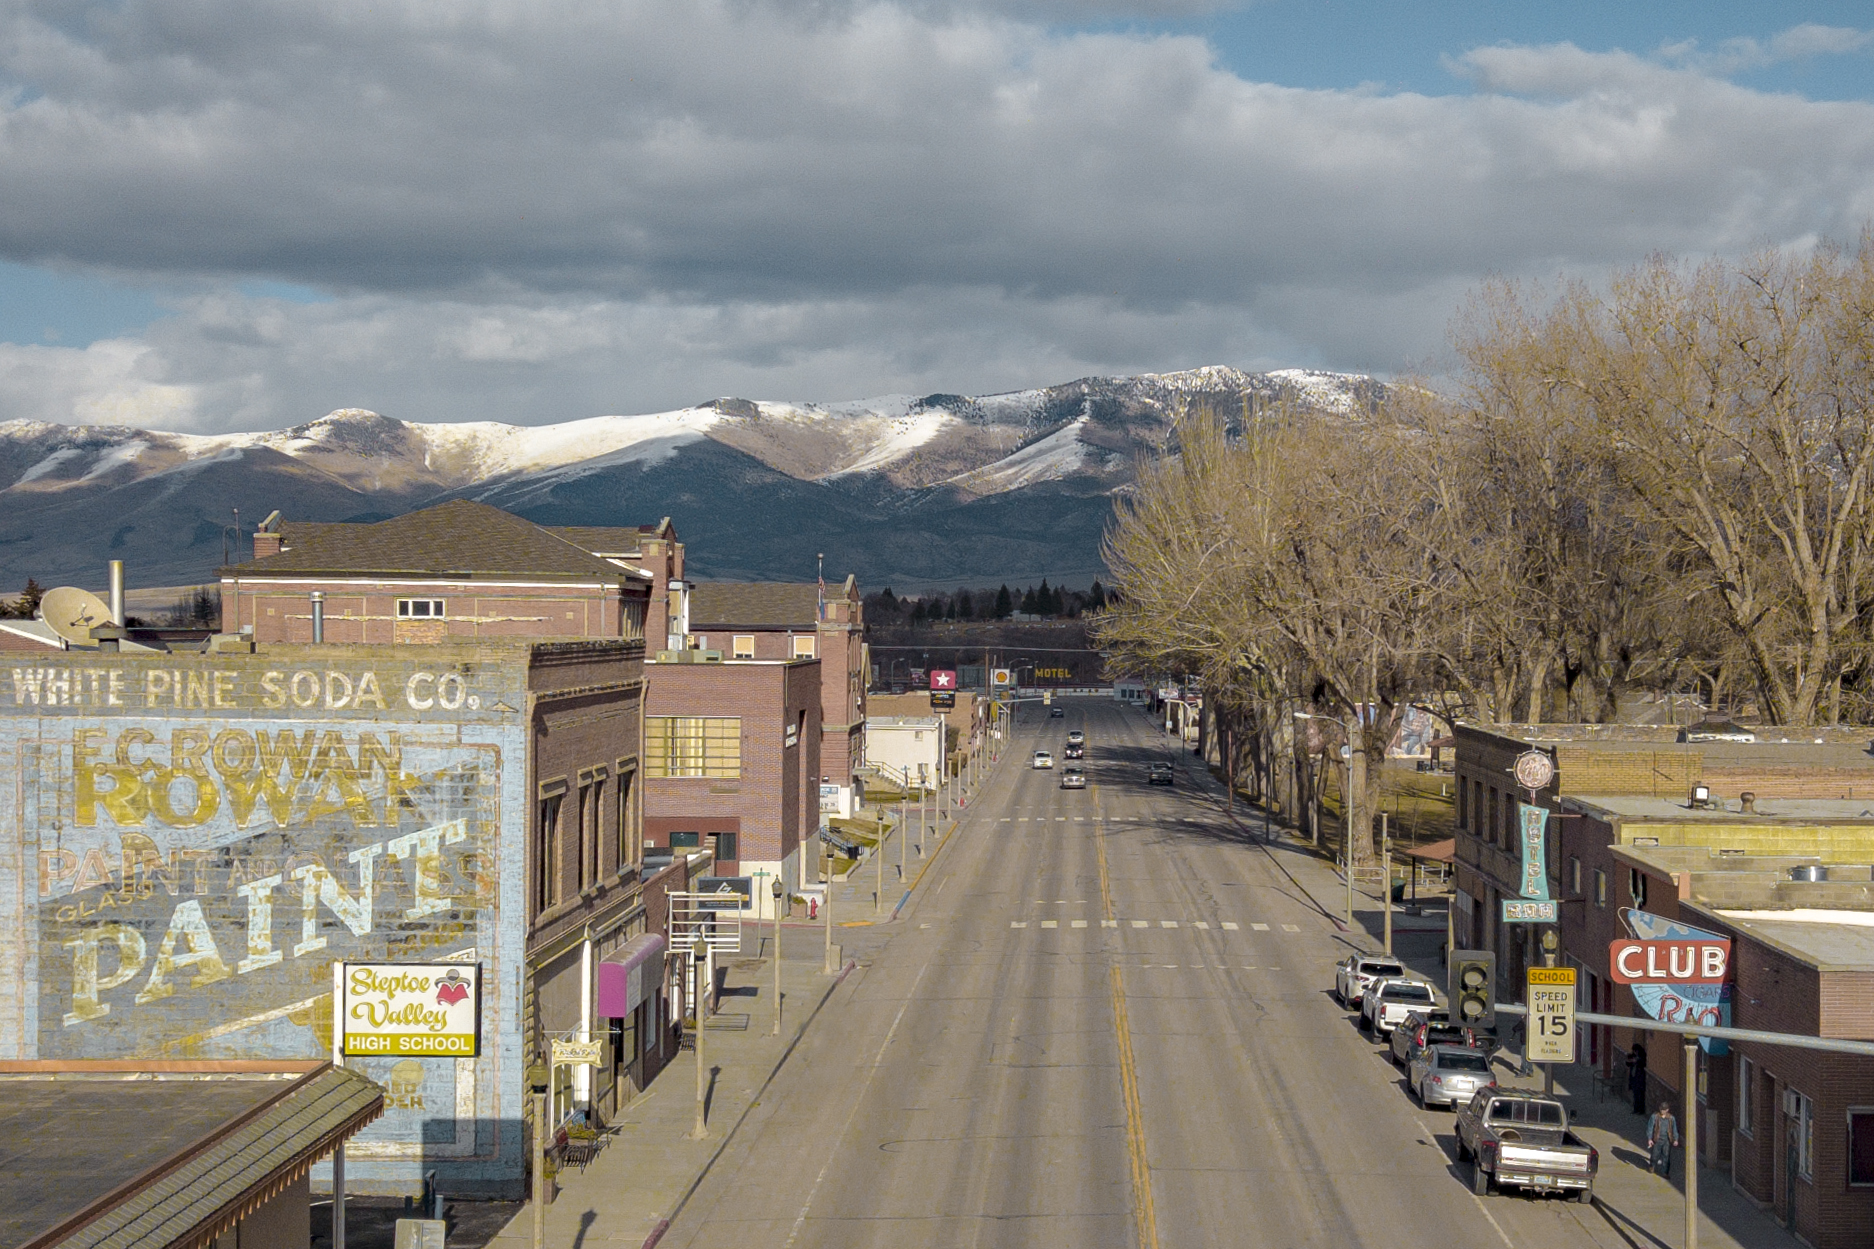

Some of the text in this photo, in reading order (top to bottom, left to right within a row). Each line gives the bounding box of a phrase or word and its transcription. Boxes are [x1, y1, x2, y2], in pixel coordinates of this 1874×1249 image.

[1035, 668, 1072, 678] MOTEL
[12, 668, 480, 710] WHITE PINE SODA CO.
[1526, 809, 1542, 895] HOTEL
[38, 848, 218, 897] PAINT
[62, 818, 468, 1027] PAINT
[1617, 945, 1726, 978] CLUB
[350, 968, 431, 999] Steptoe
[1531, 972, 1572, 982] SCHOOL
[1535, 992, 1567, 1001] SPEED
[1683, 984, 1730, 998] CIGARS
[350, 999, 448, 1032] Valley
[1536, 1003, 1566, 1013] LIMIT
[1538, 1015, 1568, 1036] 15
[349, 1037, 470, 1050] HIGH SCHOOL
